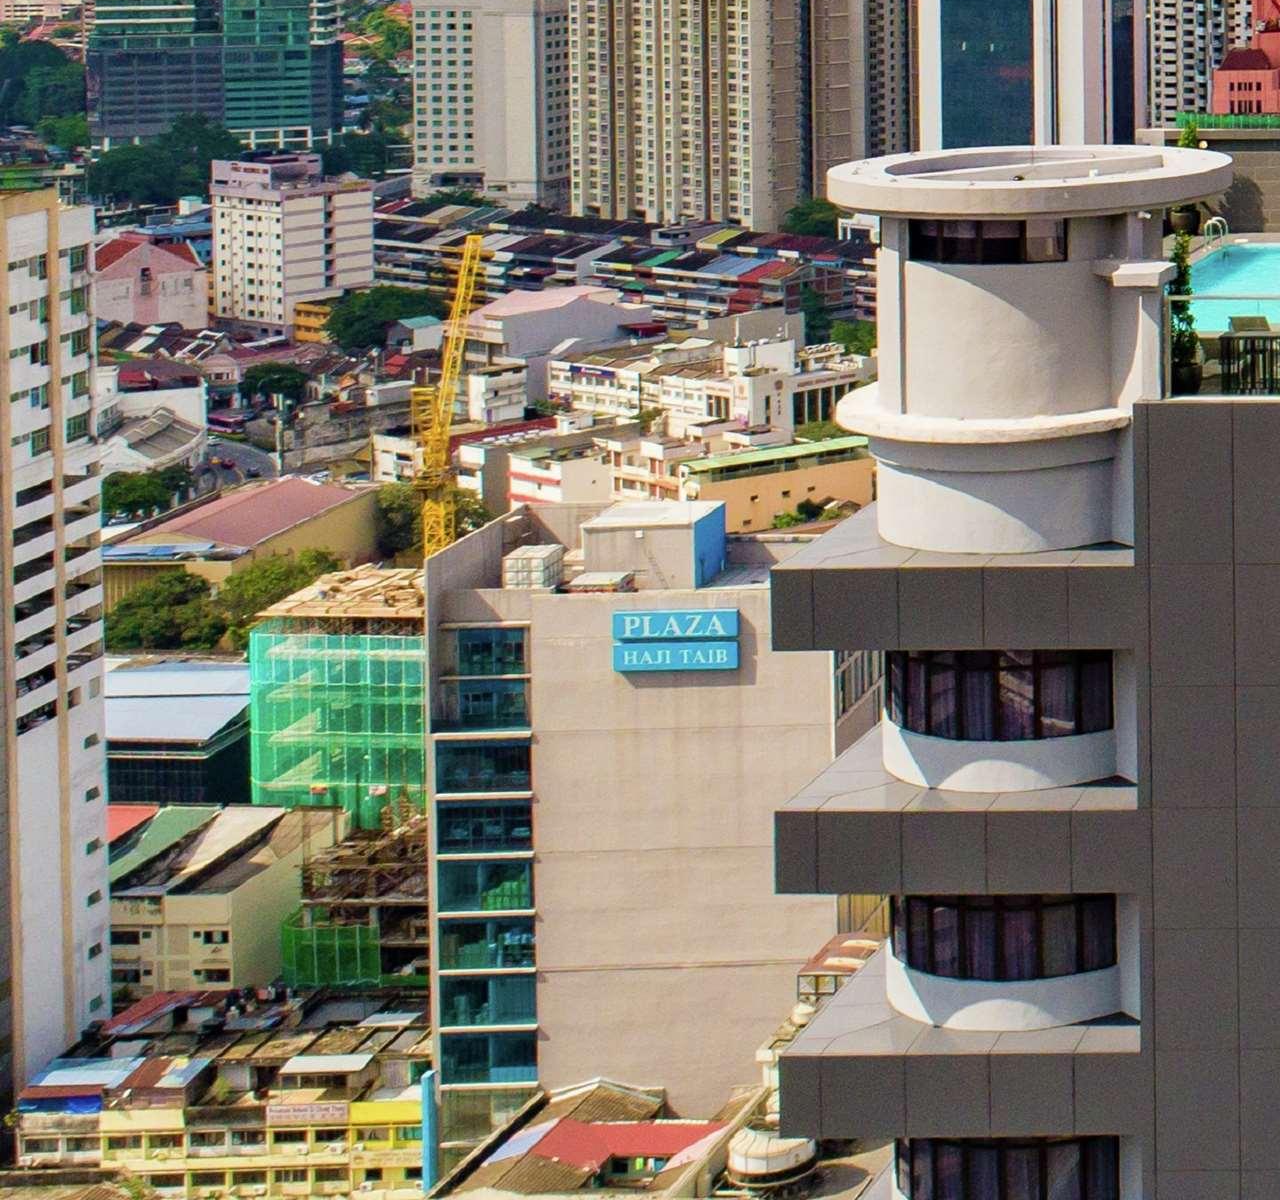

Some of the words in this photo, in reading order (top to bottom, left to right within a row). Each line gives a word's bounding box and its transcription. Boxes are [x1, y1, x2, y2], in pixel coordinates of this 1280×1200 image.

[623, 614, 728, 637] PLAZA
[623, 649, 672, 665] HAJI
[680, 648, 729, 664] TAIB
